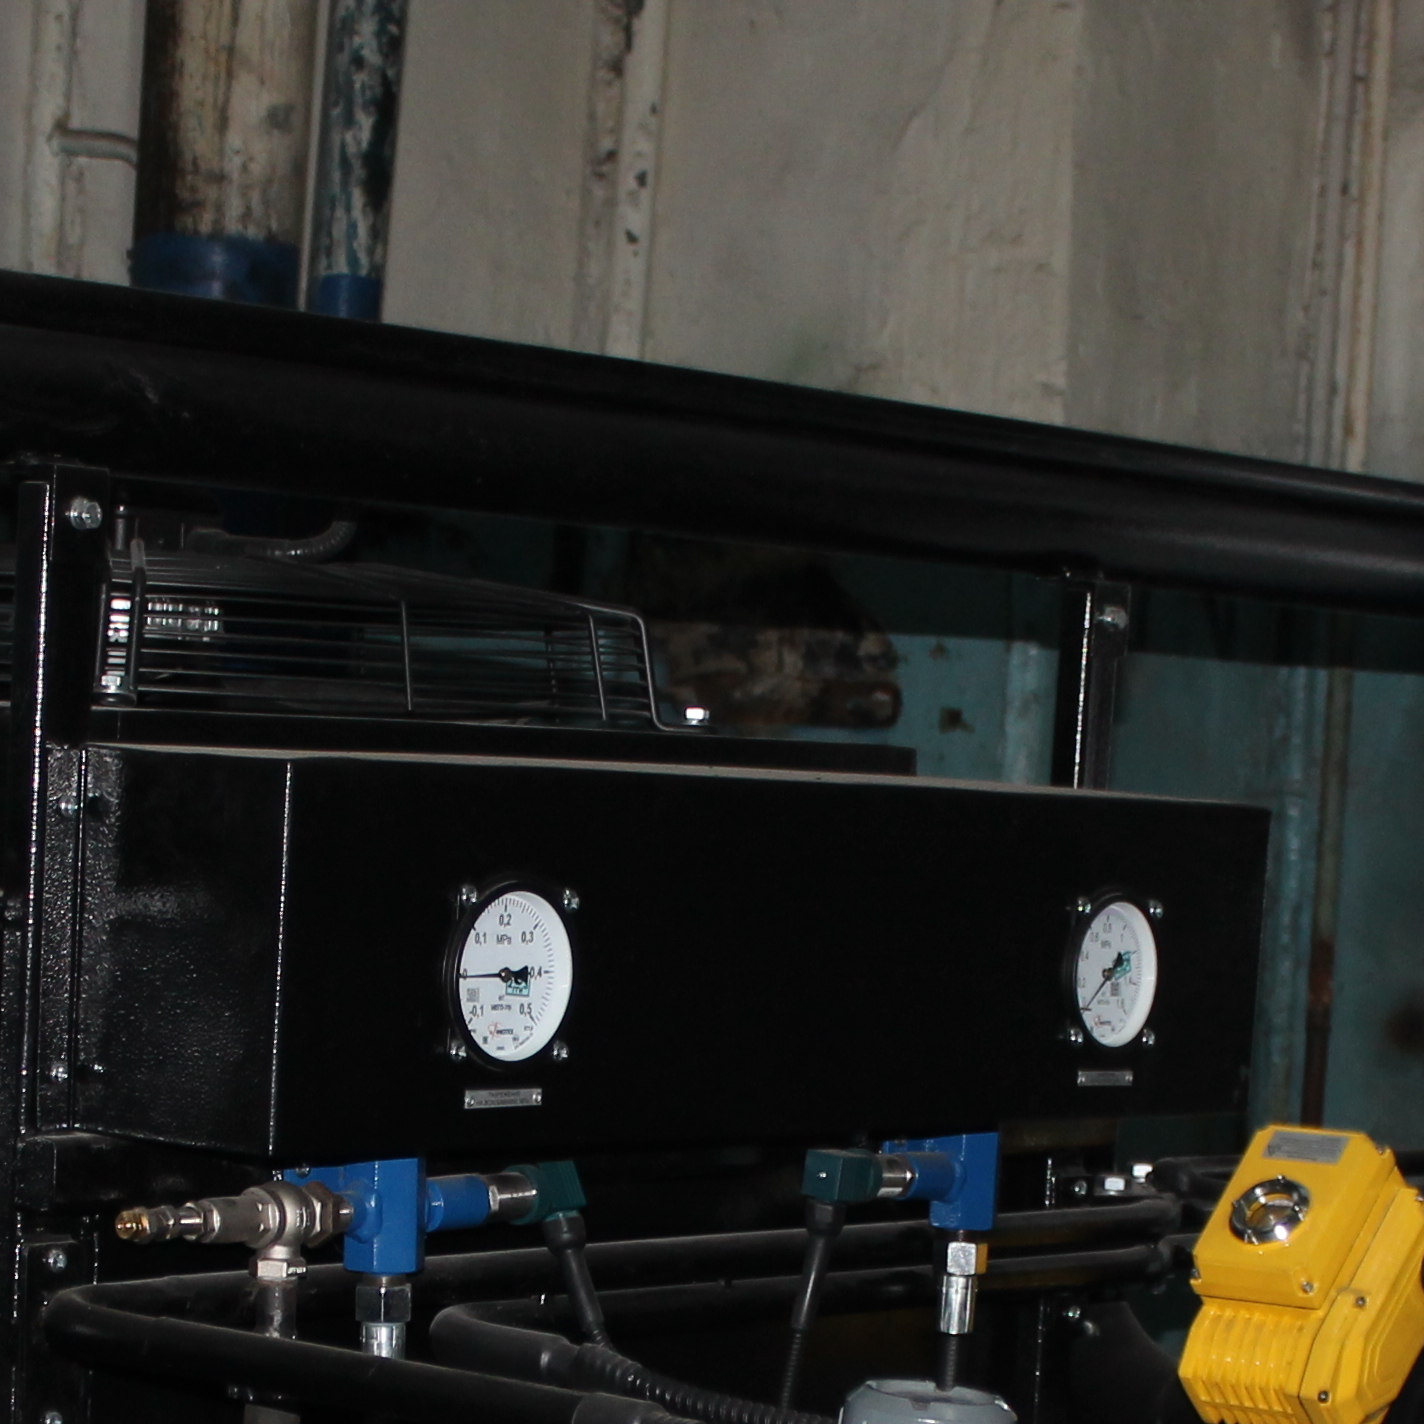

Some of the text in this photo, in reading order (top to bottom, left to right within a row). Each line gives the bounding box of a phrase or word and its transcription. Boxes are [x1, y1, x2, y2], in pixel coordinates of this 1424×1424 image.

[499, 914, 512, 927] 0,2
[474, 933, 487, 946] 0,1
[521, 931, 534, 945] 0,3
[519, 1002, 532, 1016] 0,5
